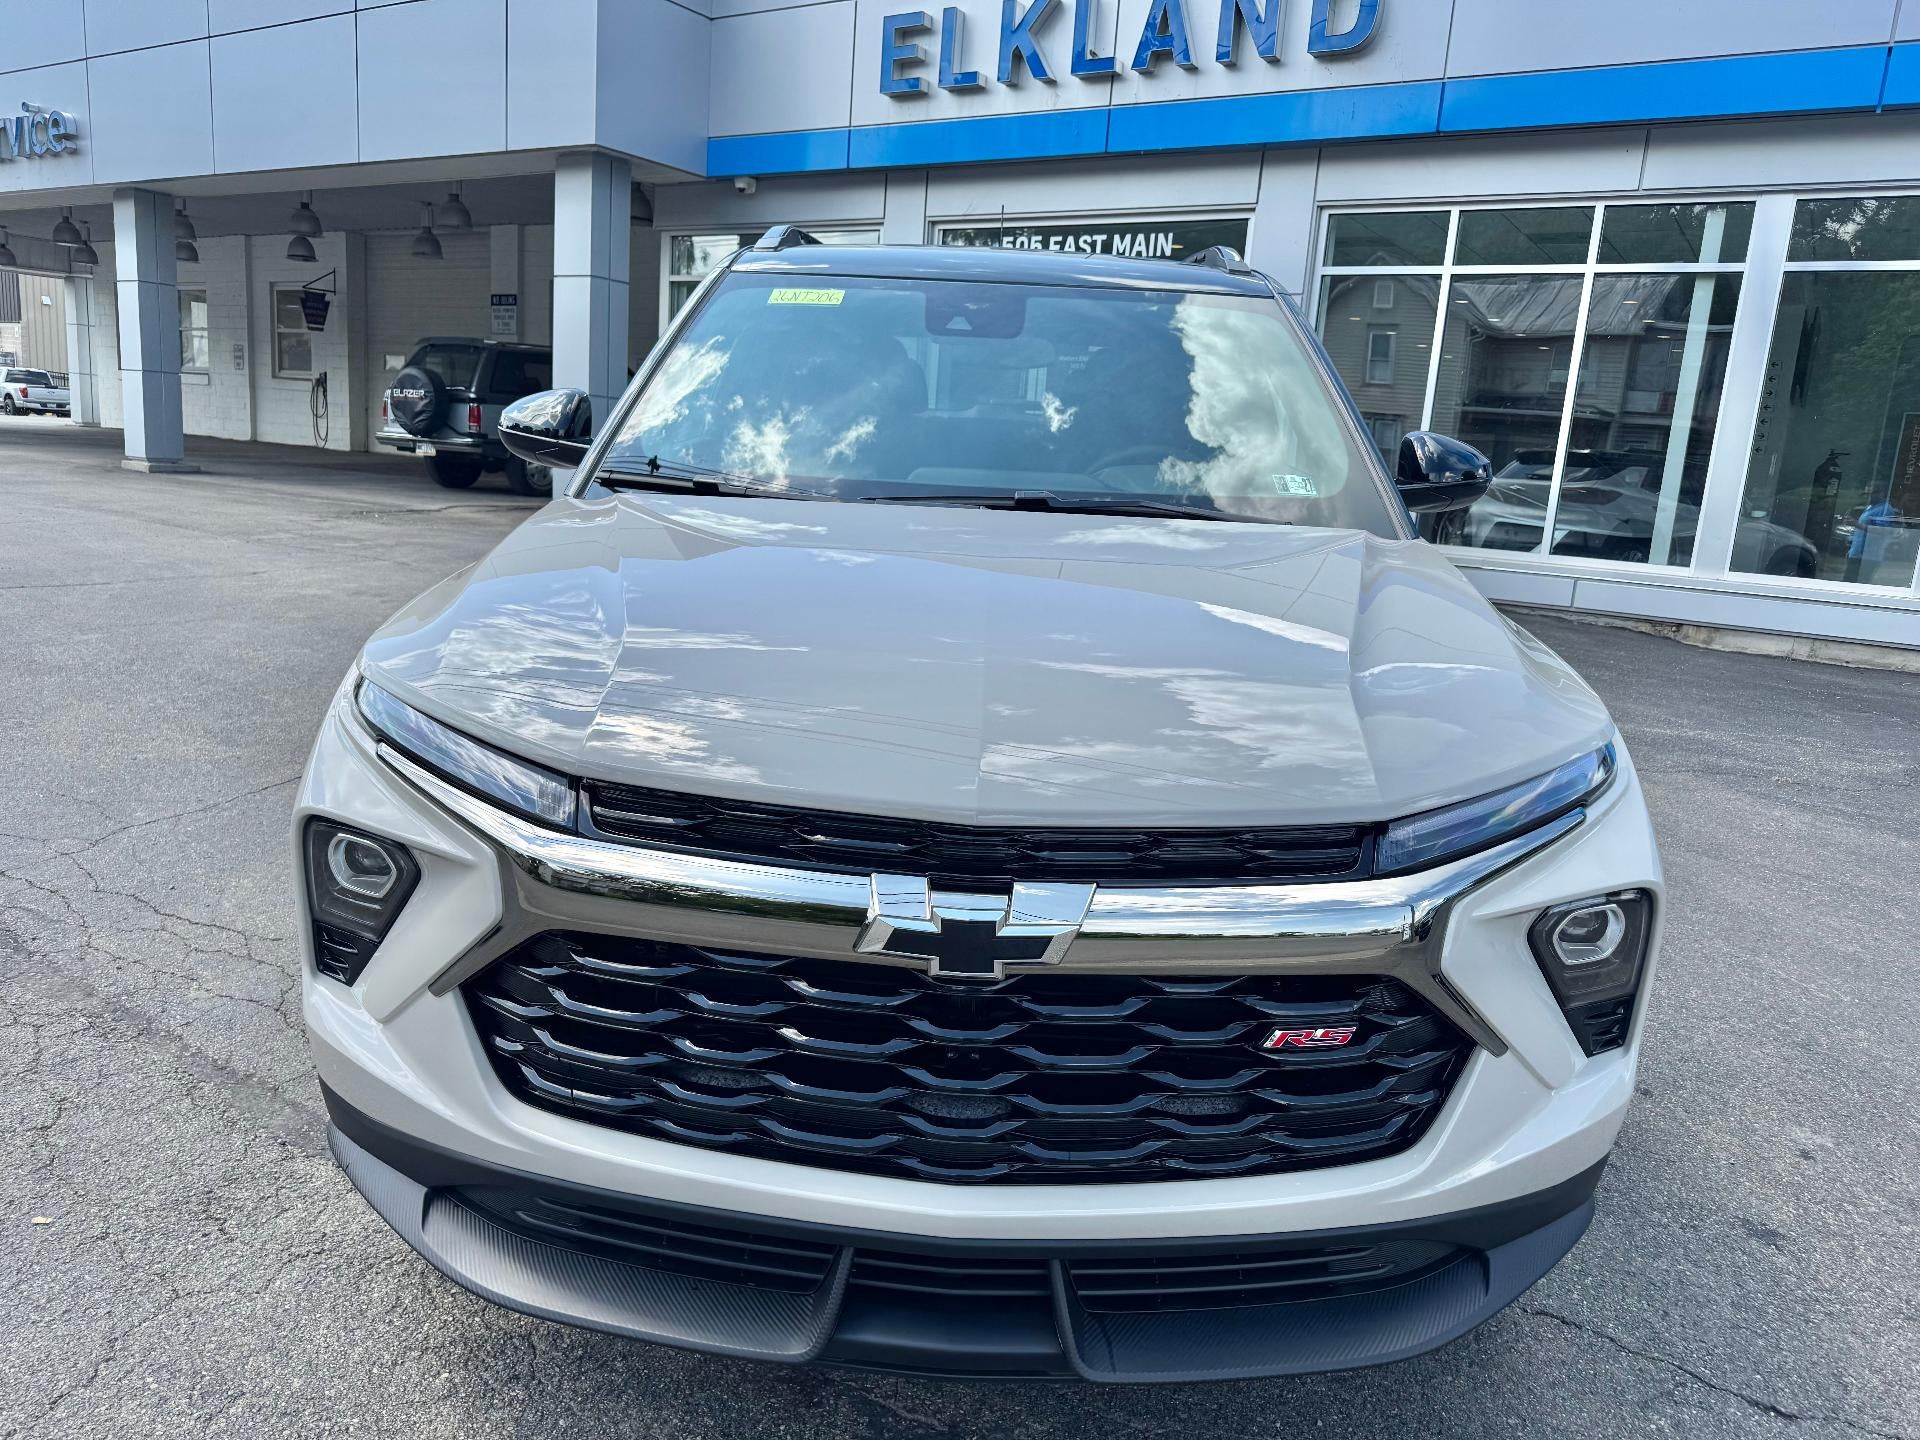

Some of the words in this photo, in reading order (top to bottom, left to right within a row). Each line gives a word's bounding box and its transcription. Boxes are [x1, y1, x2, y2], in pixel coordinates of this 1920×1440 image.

[879, 0, 1384, 97] ELKLAND
[1049, 234, 1107, 254] EAST
[1111, 232, 1174, 257] MAIN
[393, 388, 425, 398] BLAZER
[1262, 1026, 1357, 1049] RS
